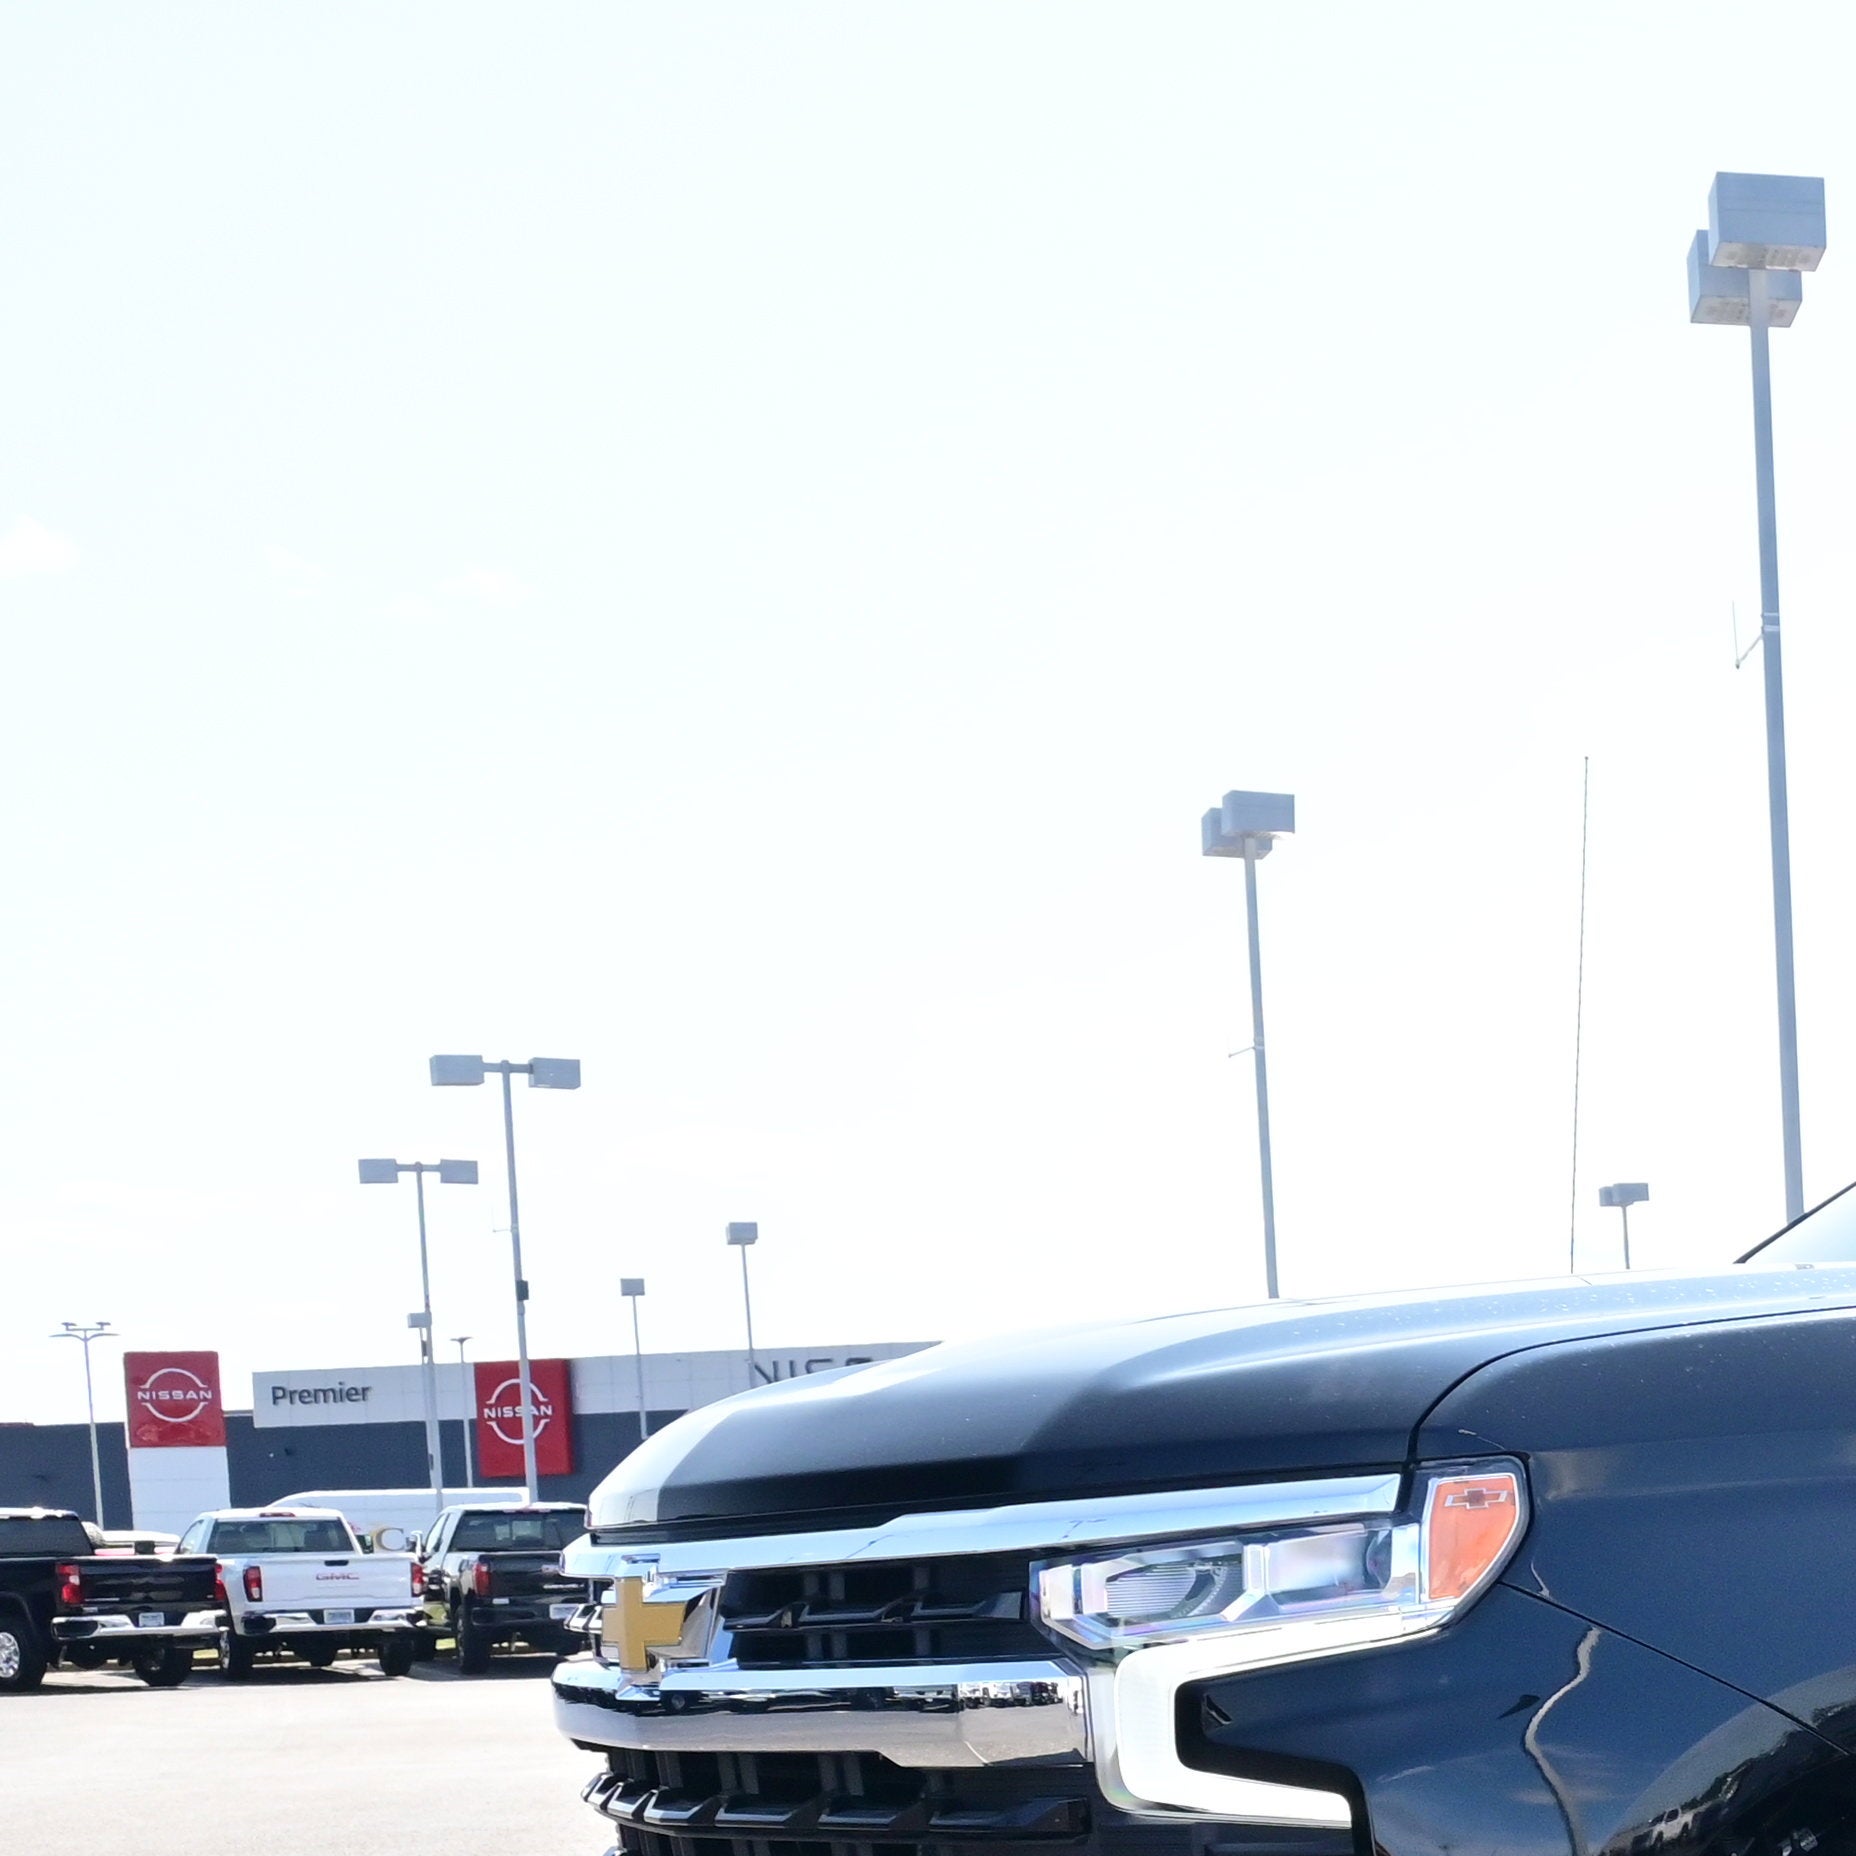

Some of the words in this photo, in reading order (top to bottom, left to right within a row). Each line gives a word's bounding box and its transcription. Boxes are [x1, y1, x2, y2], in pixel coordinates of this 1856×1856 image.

[137, 1389, 212, 1400] NISSAN
[271, 1381, 372, 1405] Premier
[315, 1572, 360, 1581] GMC
